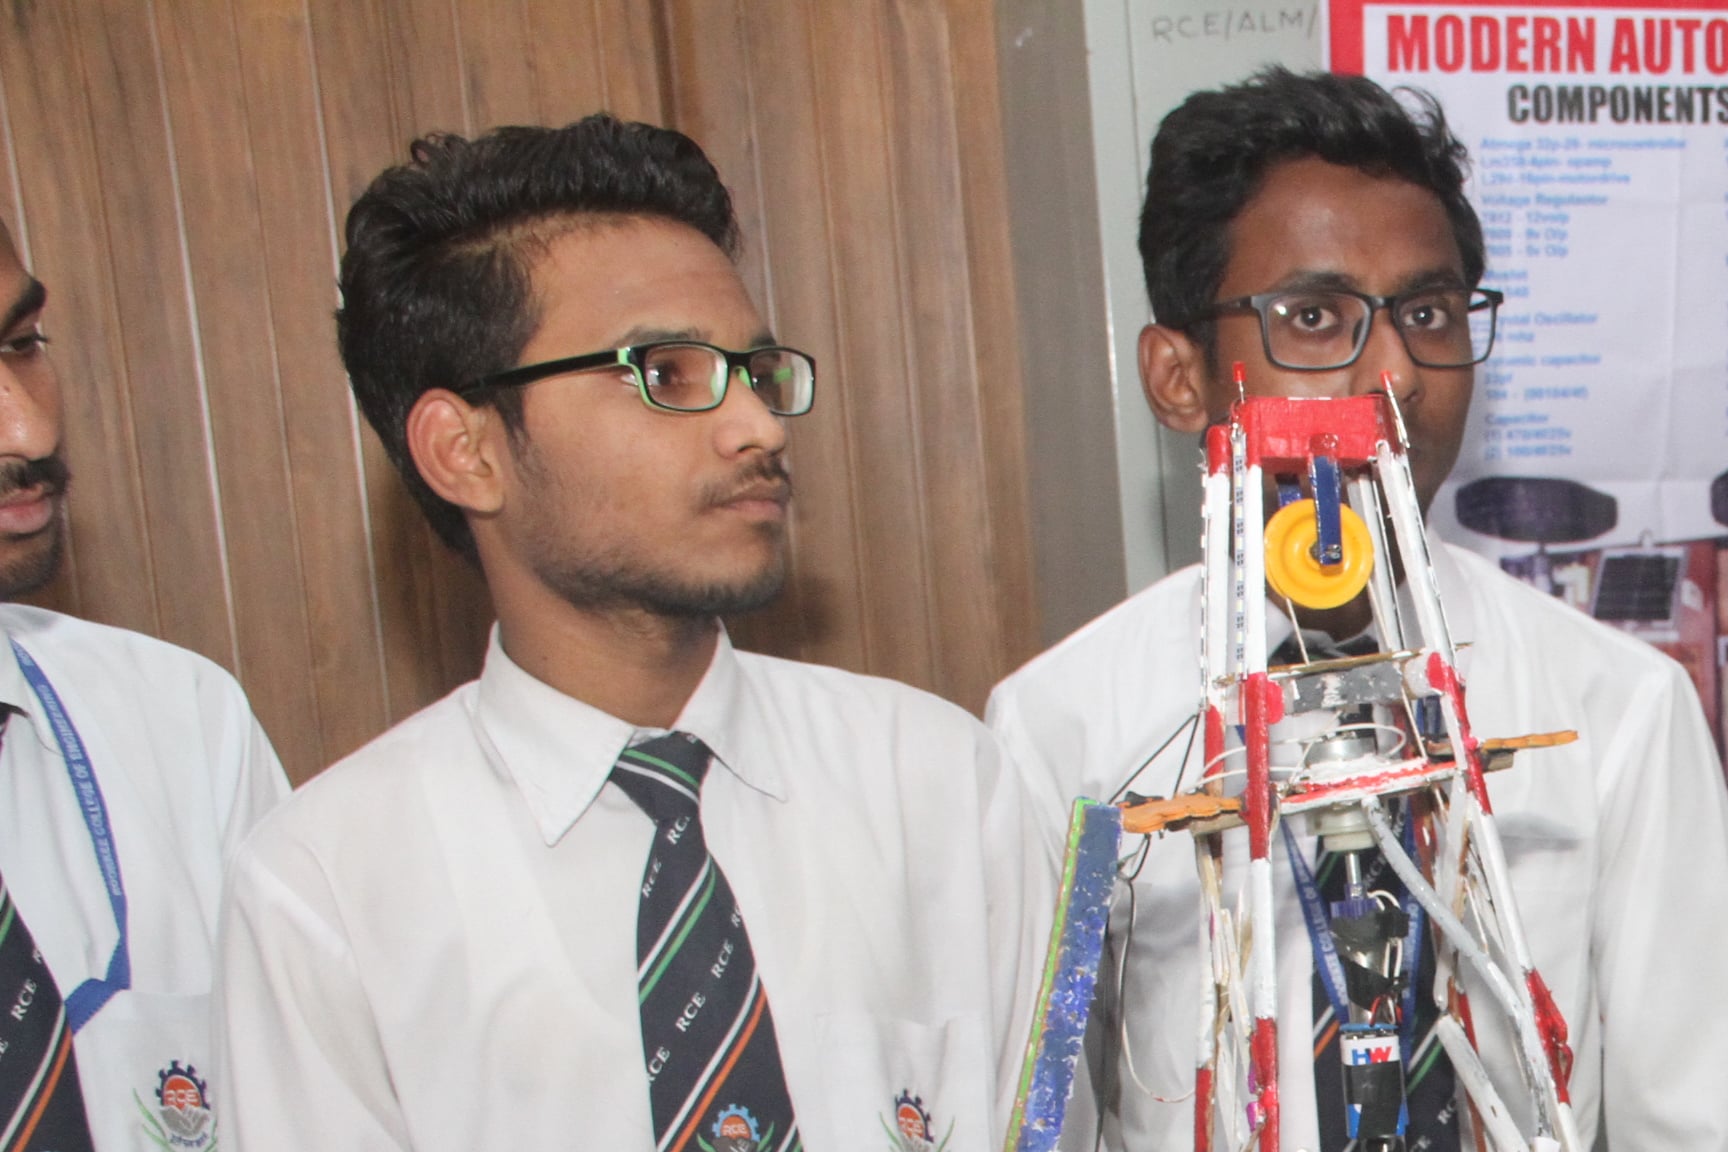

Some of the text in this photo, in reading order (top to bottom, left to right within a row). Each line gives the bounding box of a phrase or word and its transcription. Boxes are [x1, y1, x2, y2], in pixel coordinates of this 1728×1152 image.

[1387, 13, 1596, 74] MODERN
[710, 941, 734, 979] RCE
[10, 978, 38, 1023] RCE
[675, 991, 706, 1033] RCE
[165, 1088, 198, 1104] RCE
